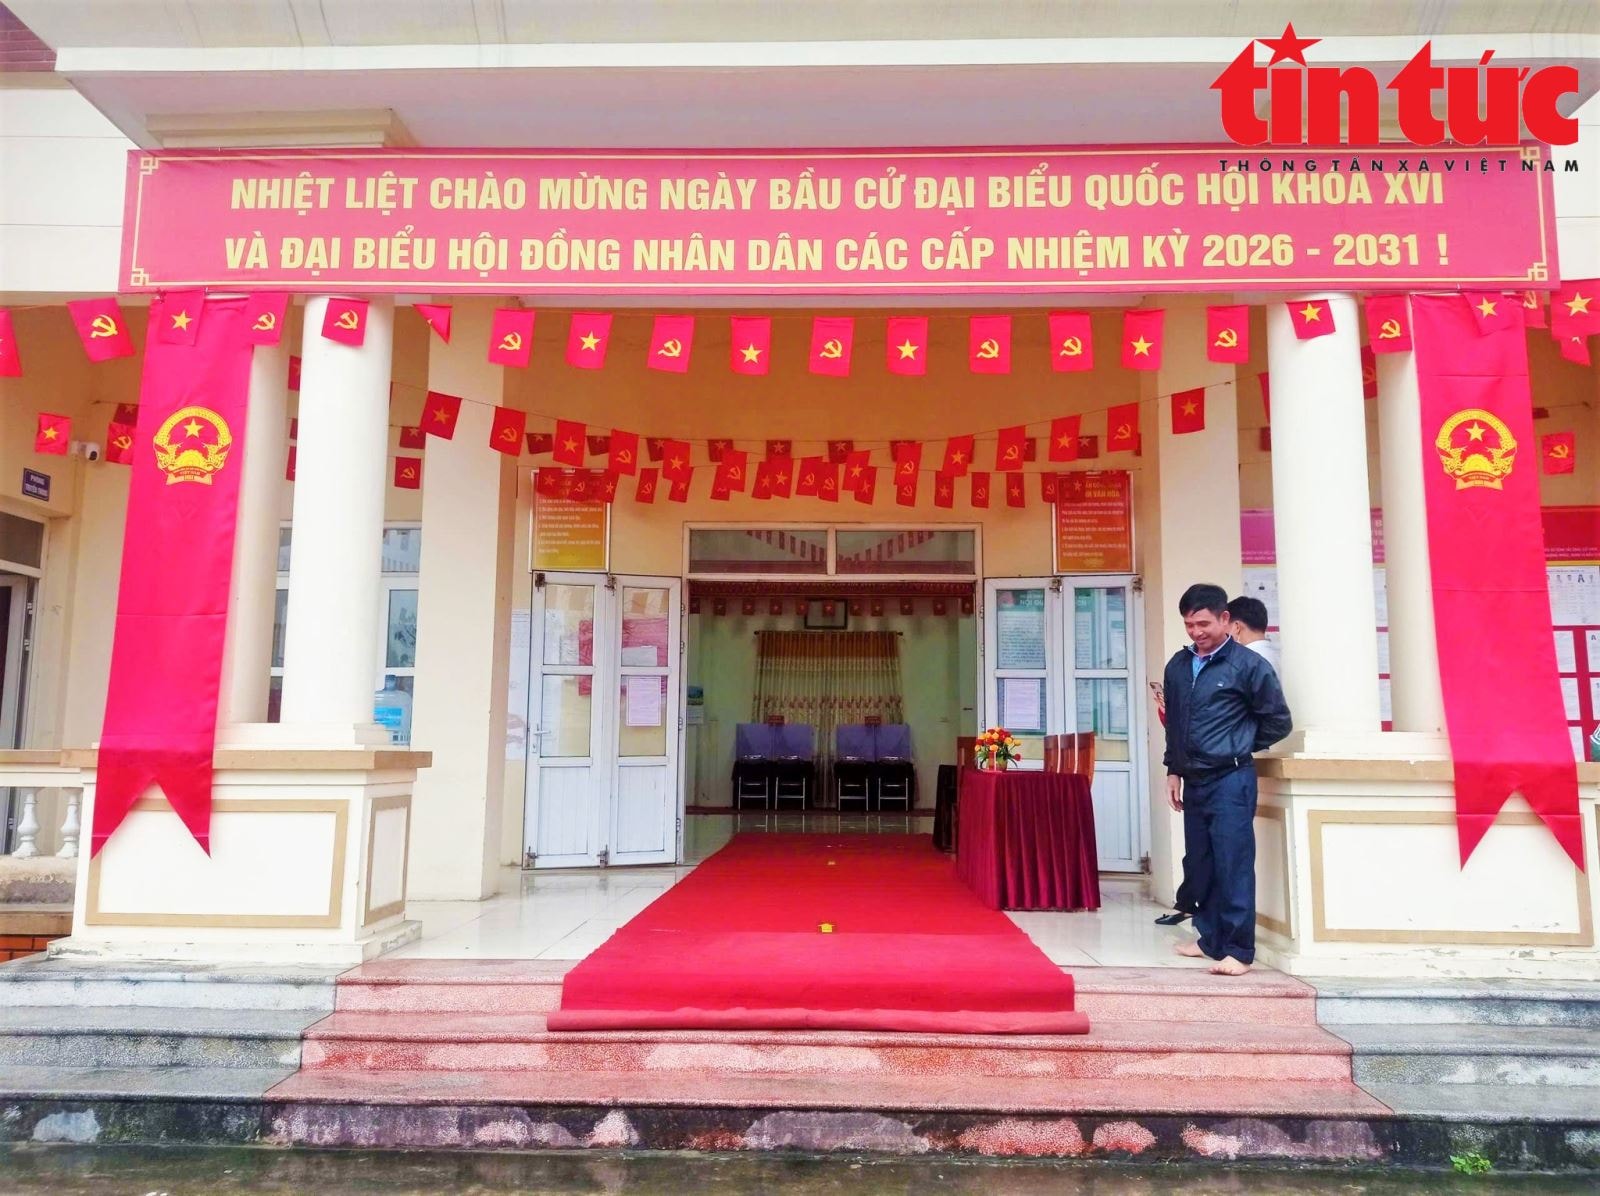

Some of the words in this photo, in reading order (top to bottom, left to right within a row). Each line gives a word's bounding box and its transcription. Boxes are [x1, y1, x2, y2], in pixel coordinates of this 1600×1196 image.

[230, 171, 336, 215] NHIỆT
[345, 170, 419, 215] LIỆT
[429, 171, 526, 210] CHÀO
[538, 171, 648, 211] MỪNG
[660, 171, 757, 211] NGÀY
[769, 166, 842, 210] BẦU
[854, 165, 907, 210] CỬ
[913, 176, 975, 216] ĐẠI
[988, 162, 1072, 208] BIỂU
[1084, 161, 1185, 211] QUỐC
[1197, 165, 1259, 212] HỘI
[1271, 166, 1373, 205] KHÓA
[1383, 172, 1444, 204] XVI
[224, 230, 269, 270] VÀ
[279, 236, 341, 277] ĐẠI
[352, 224, 436, 271] BIỂU
[447, 231, 509, 278] HỘI
[519, 227, 621, 272] ĐỒNG
[633, 232, 735, 271] NHÂN
[747, 232, 823, 272] DÂN
[835, 231, 908, 272] CÁC
[921, 226, 995, 271] CẤP
[1007, 229, 1130, 277] NHIỆM
[1142, 227, 1190, 268] KỲ
[1202, 233, 1294, 267] 2026
[1306, 248, 1321, 256] -
[1333, 233, 1419, 266] 2031
[1437, 233, 1449, 266] !
